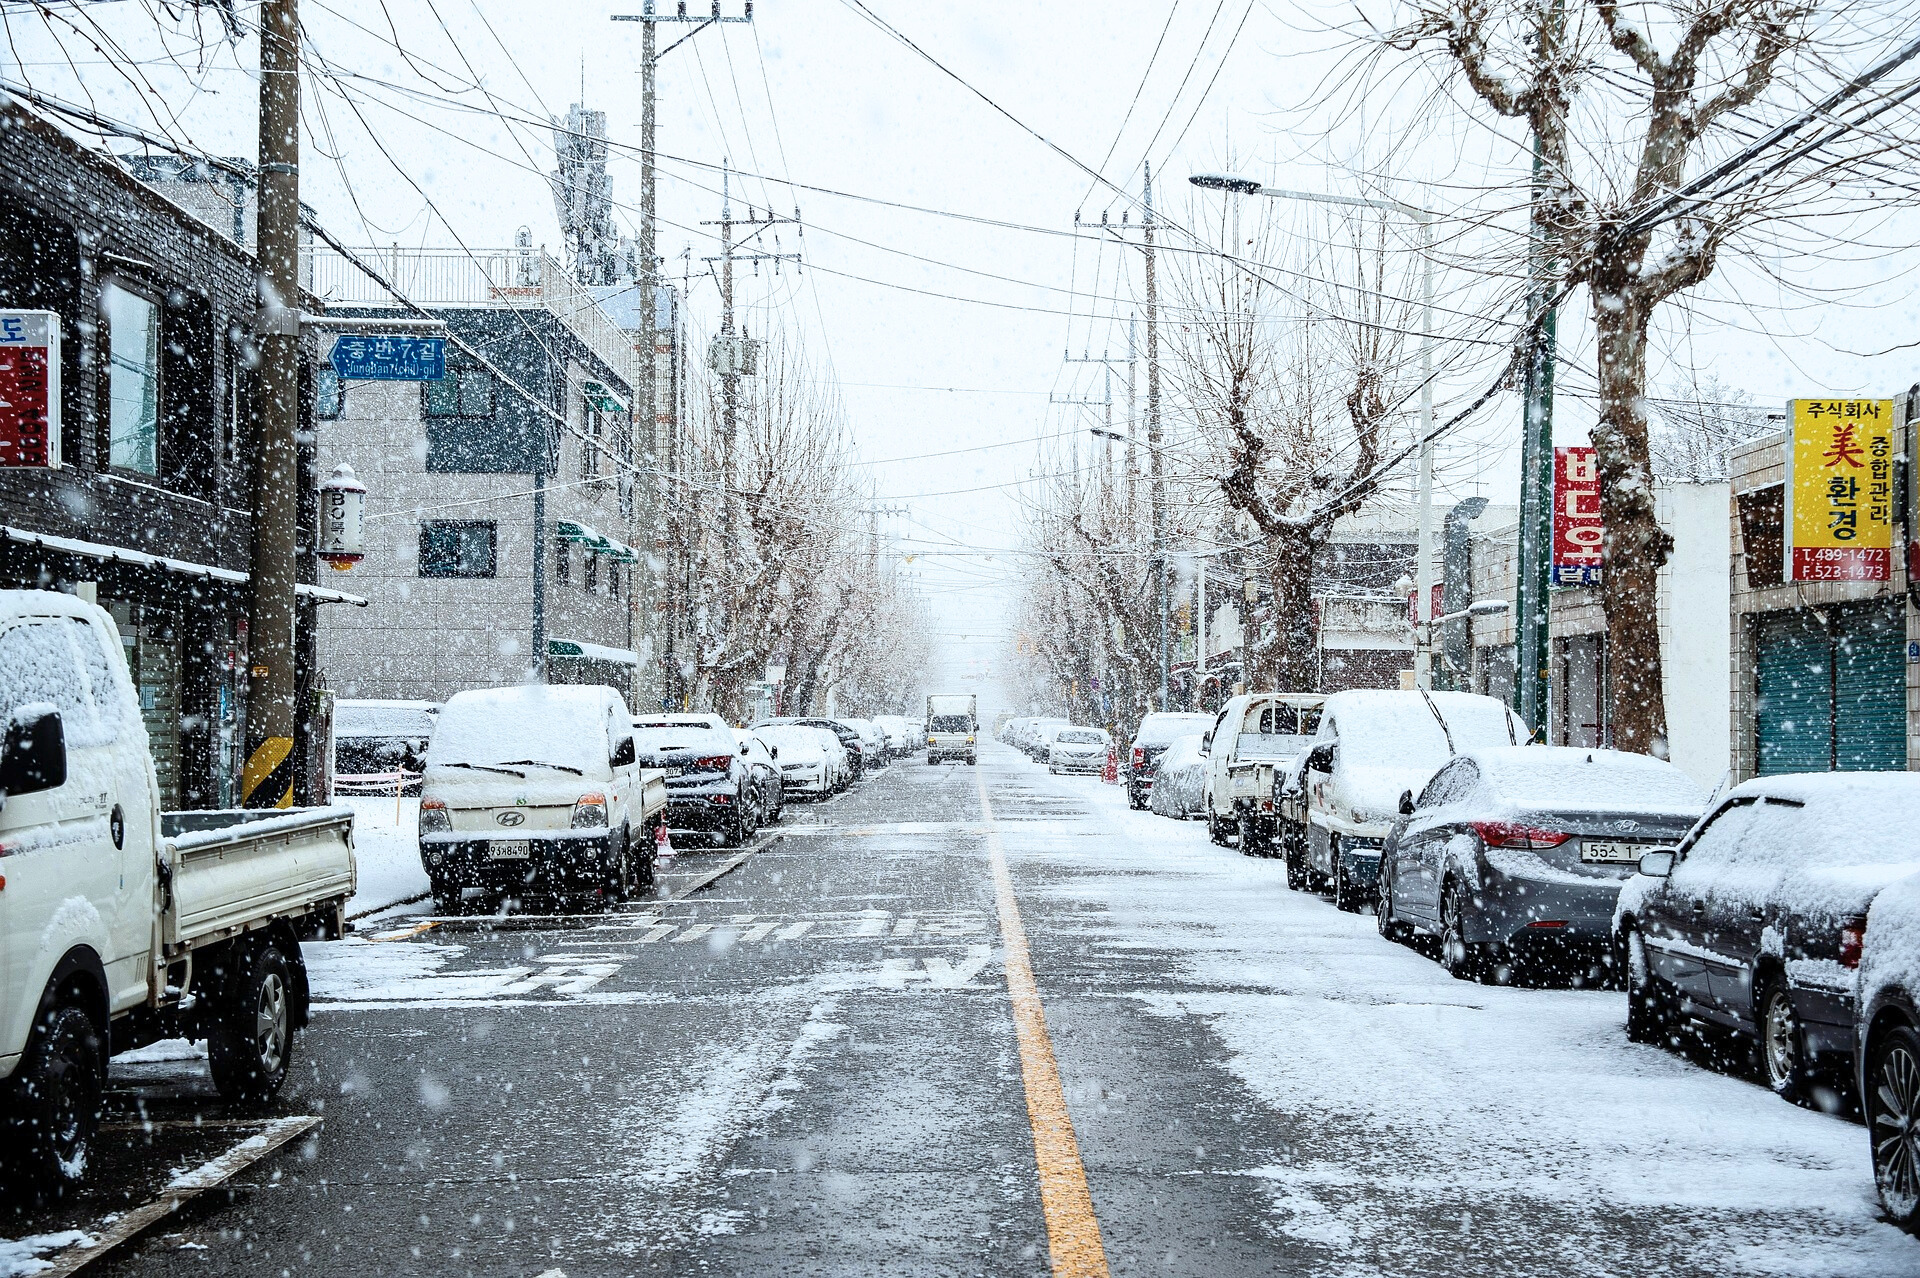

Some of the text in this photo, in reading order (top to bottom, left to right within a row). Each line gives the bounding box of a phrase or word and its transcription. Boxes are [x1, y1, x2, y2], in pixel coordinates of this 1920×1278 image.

[1807, 402, 1881, 419] 주식회사
[1822, 423, 1865, 540] 美 환경
[1869, 436, 1890, 525] 종합관리
[1802, 548, 1885, 562] T.489-1472
[1802, 565, 1884, 579] F.523-1473
